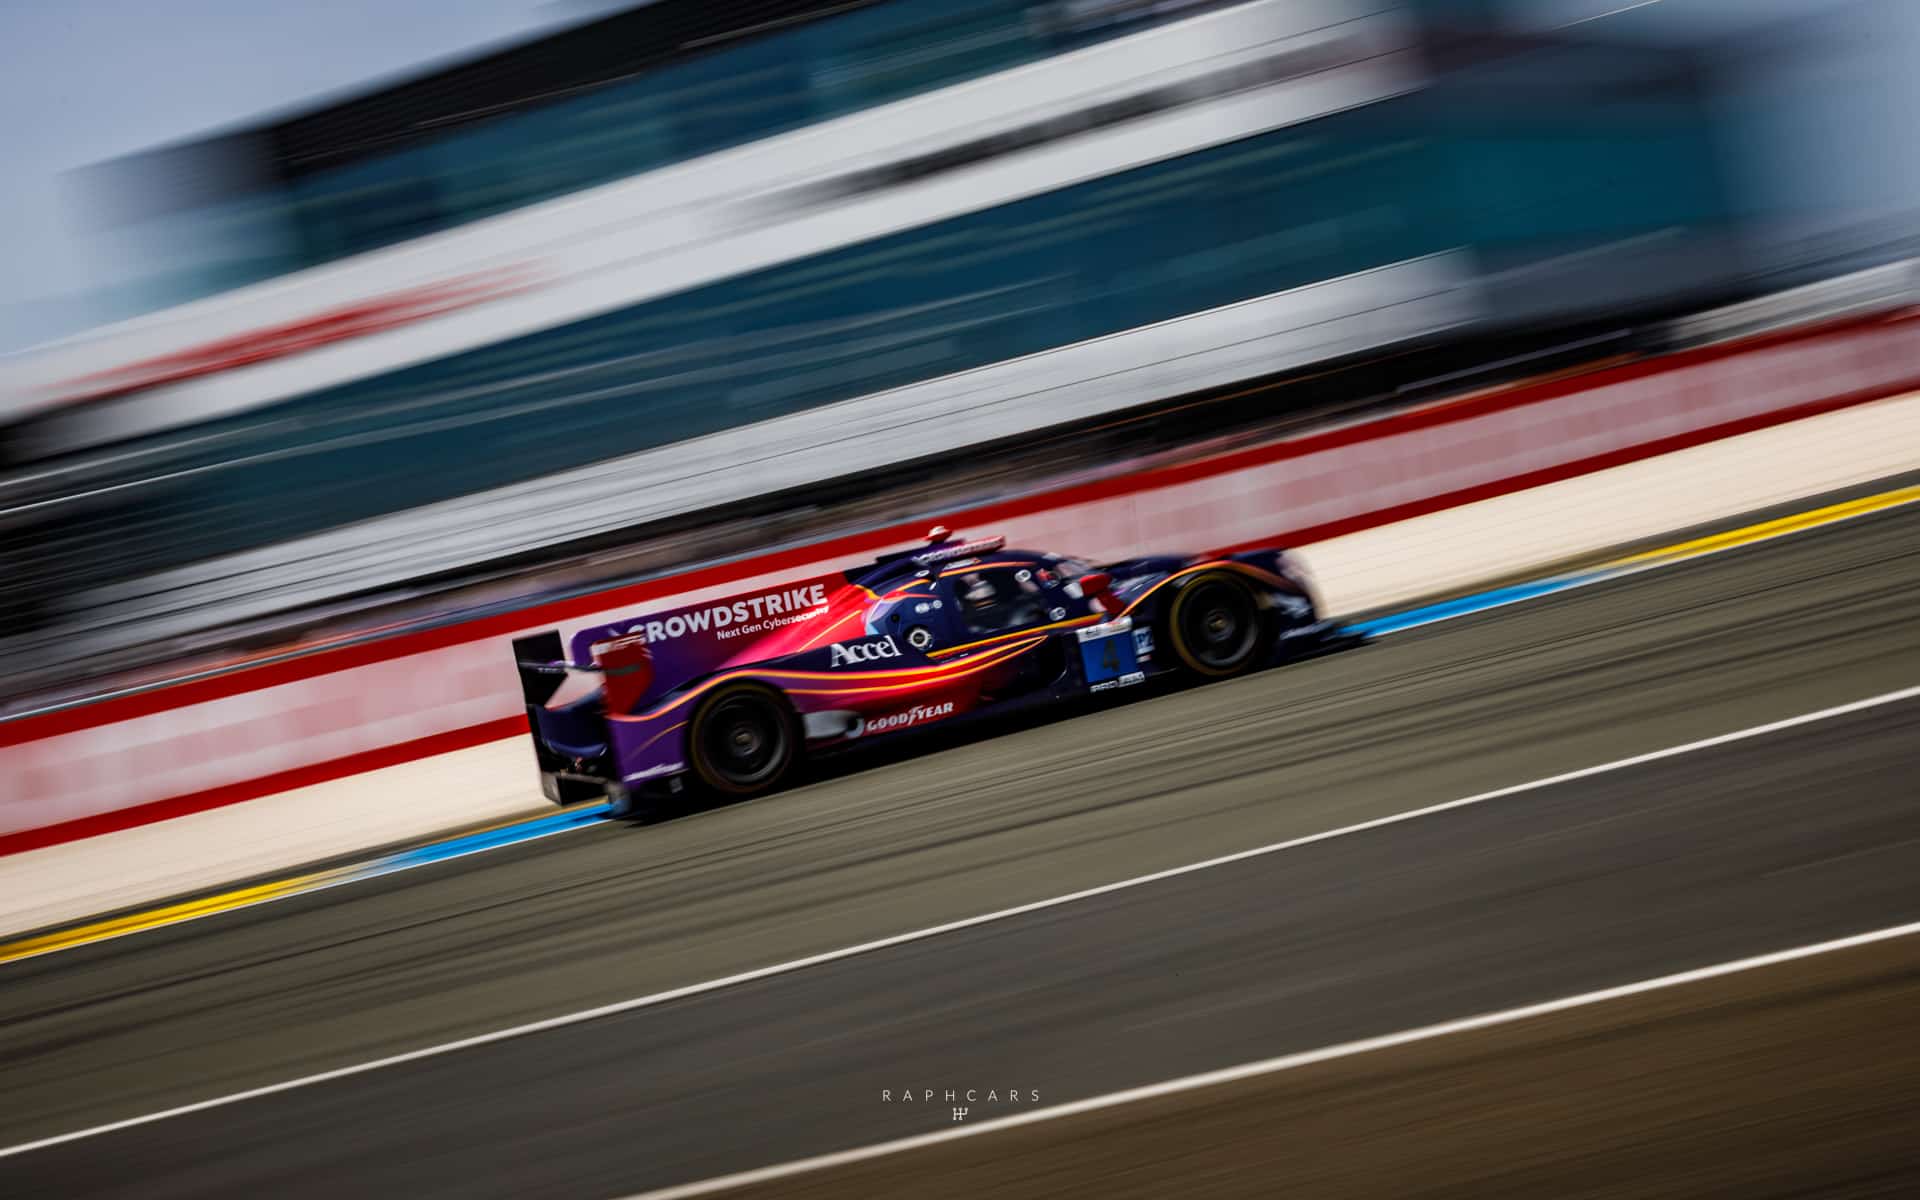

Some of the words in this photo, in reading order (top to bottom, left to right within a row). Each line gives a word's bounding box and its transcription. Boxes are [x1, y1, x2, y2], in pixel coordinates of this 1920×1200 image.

[716, 627, 741, 641] Next
[741, 620, 762, 634] Gen
[763, 605, 830, 630] Cybersecy
[830, 634, 904, 668] Accel
[866, 702, 954, 732] GOODYEAR
